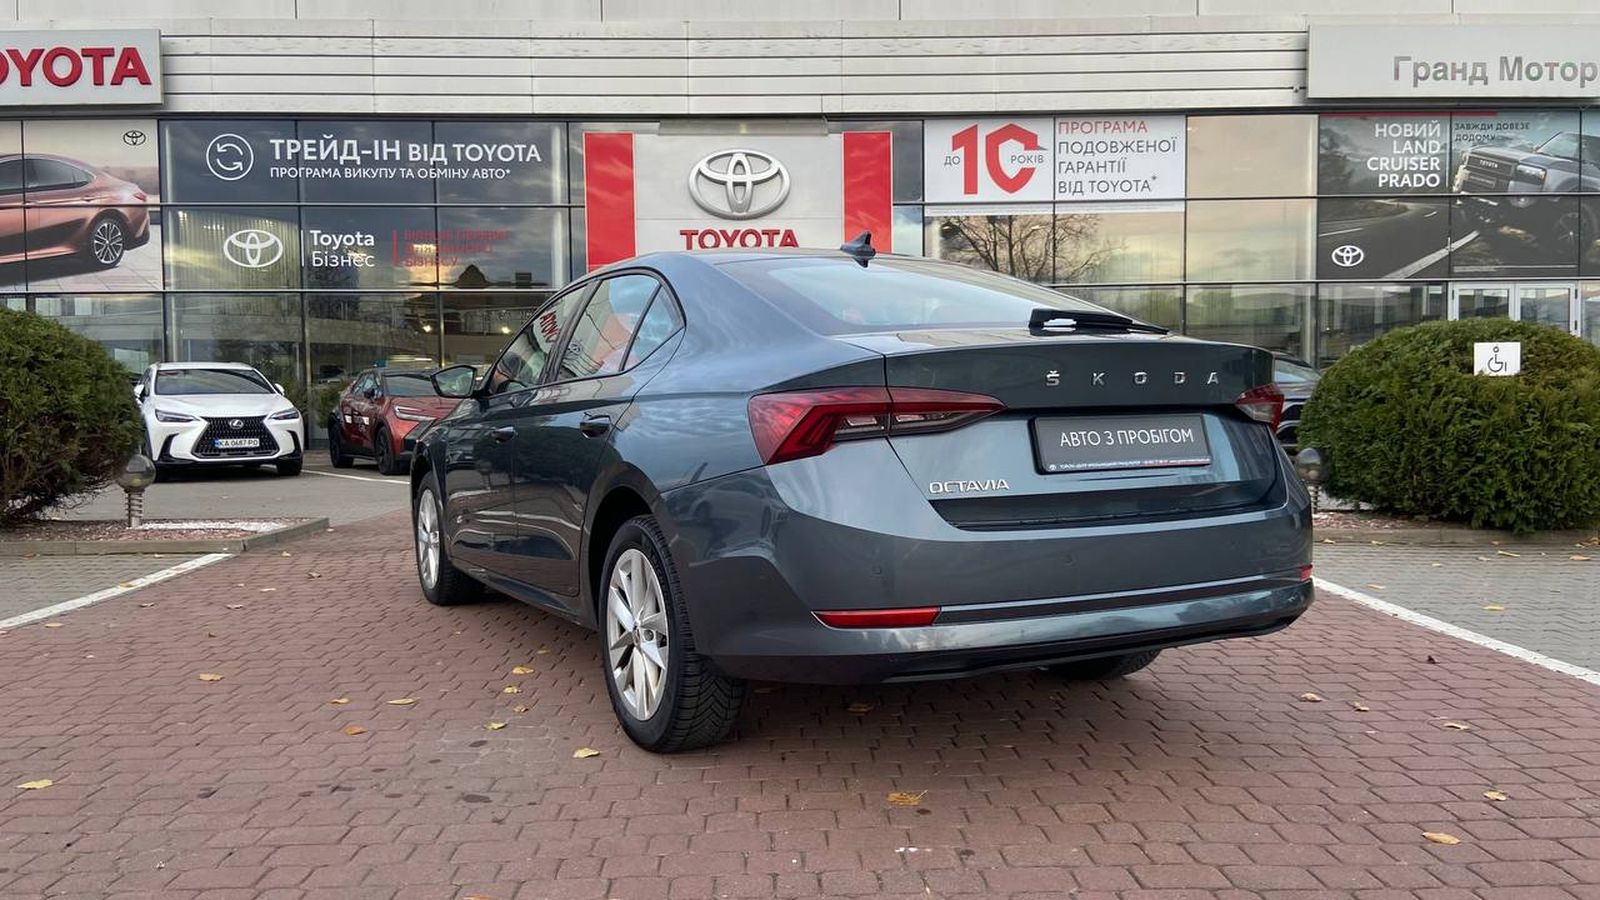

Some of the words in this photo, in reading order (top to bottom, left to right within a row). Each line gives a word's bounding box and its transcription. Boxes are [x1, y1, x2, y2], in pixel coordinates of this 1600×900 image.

[0, 46, 152, 87] YOTA
[1393, 55, 1488, 88] Гранд
[1499, 55, 1599, 88] Мотор
[1058, 121, 1148, 134] ПРОГРАМА
[1375, 120, 1440, 137] НОВИЙ
[1454, 122, 1494, 131] ЗАВЖДИ
[1496, 122, 1531, 131] ДОВЕЗЕ
[1454, 133, 1496, 142] ДОДОМУ
[269, 134, 400, 165] ТРЕЙД-ІН
[408, 143, 448, 165] ВІД
[452, 144, 542, 162] TOYOTA
[1058, 136, 1178, 156] ПОДОВЖЕНОЇ
[1393, 140, 1440, 155] LAND
[944, 155, 961, 166] ДО
[1010, 155, 1044, 164] РОКІВ
[1058, 156, 1127, 174] ГАРАНТІЇ
[1366, 156, 1441, 171] CRUISER
[270, 167, 341, 178] ПРОГРАМА
[344, 167, 396, 178] ВИКУПУ
[399, 167, 414, 178] ТА
[417, 168, 469, 179] ОБМІНУ
[1378, 173, 1441, 188] PRADO
[1058, 180, 1084, 196] ВІД
[310, 230, 375, 250] Toyota
[679, 228, 799, 250] TOYOTA
[312, 252, 375, 267] Бізнес
[1046, 370, 1219, 386] ŠKODA
[1060, 430, 1100, 447] АВТО
[1105, 431, 1115, 446] З
[1117, 427, 1195, 445] ПРОБІГОМ
[929, 479, 1009, 494] OCTAVIA
